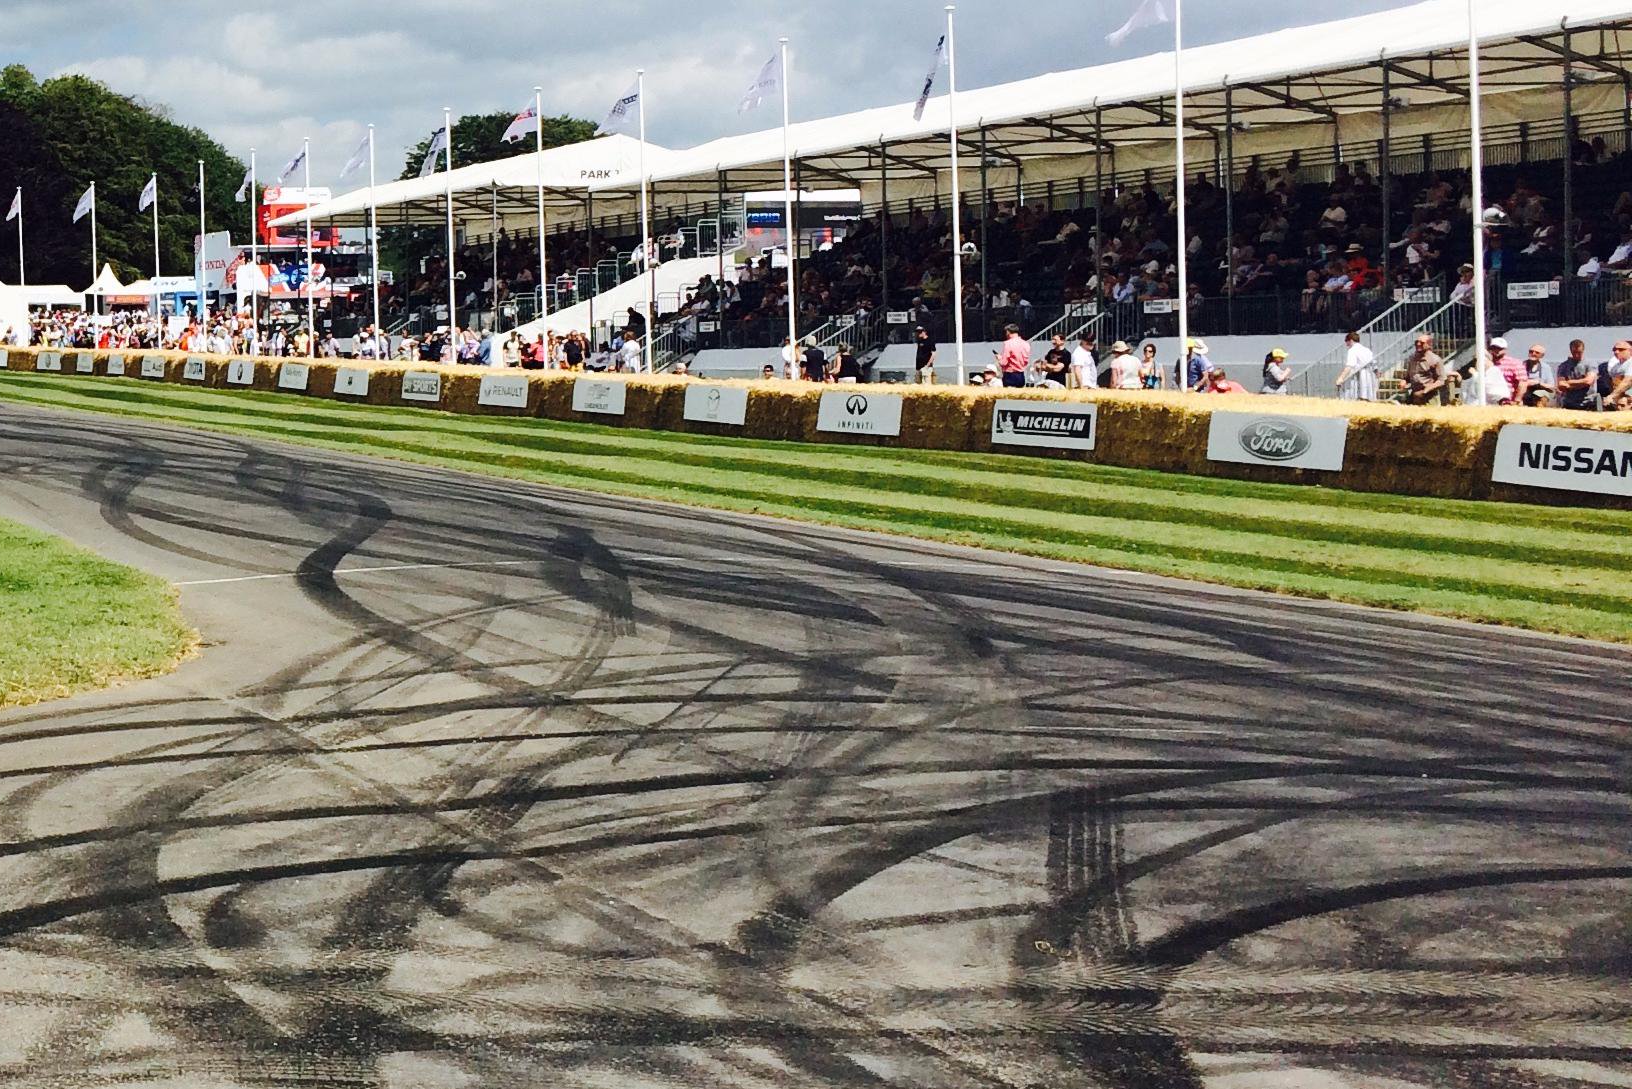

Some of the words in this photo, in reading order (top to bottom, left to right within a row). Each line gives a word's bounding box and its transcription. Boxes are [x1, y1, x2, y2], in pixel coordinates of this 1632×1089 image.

[580, 169, 611, 179] PARK
[1017, 415, 1086, 431] MICHELIN
[1250, 422, 1298, 453] Ford
